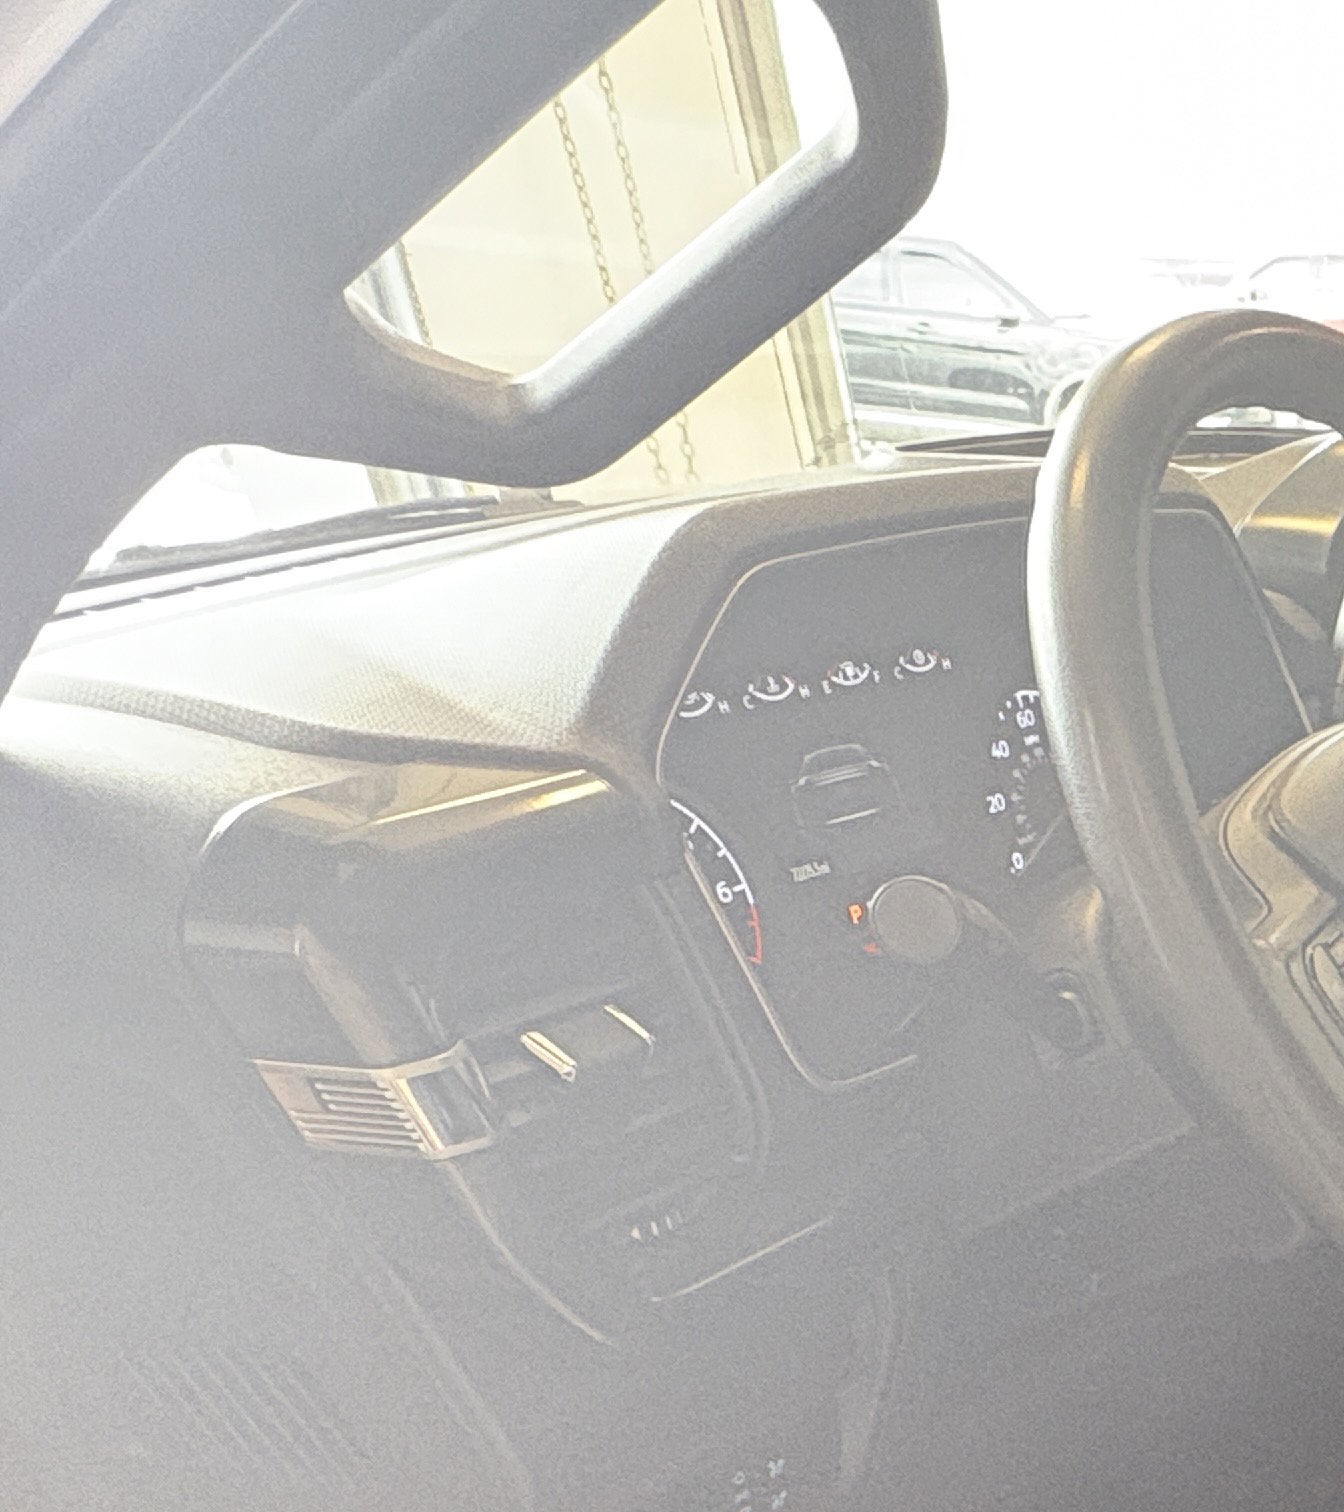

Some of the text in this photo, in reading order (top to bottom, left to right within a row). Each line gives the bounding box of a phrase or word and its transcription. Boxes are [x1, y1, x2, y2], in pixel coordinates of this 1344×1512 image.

[990, 739, 1010, 758] 40
[986, 792, 1006, 813] 20
[715, 880, 734, 903] 6
